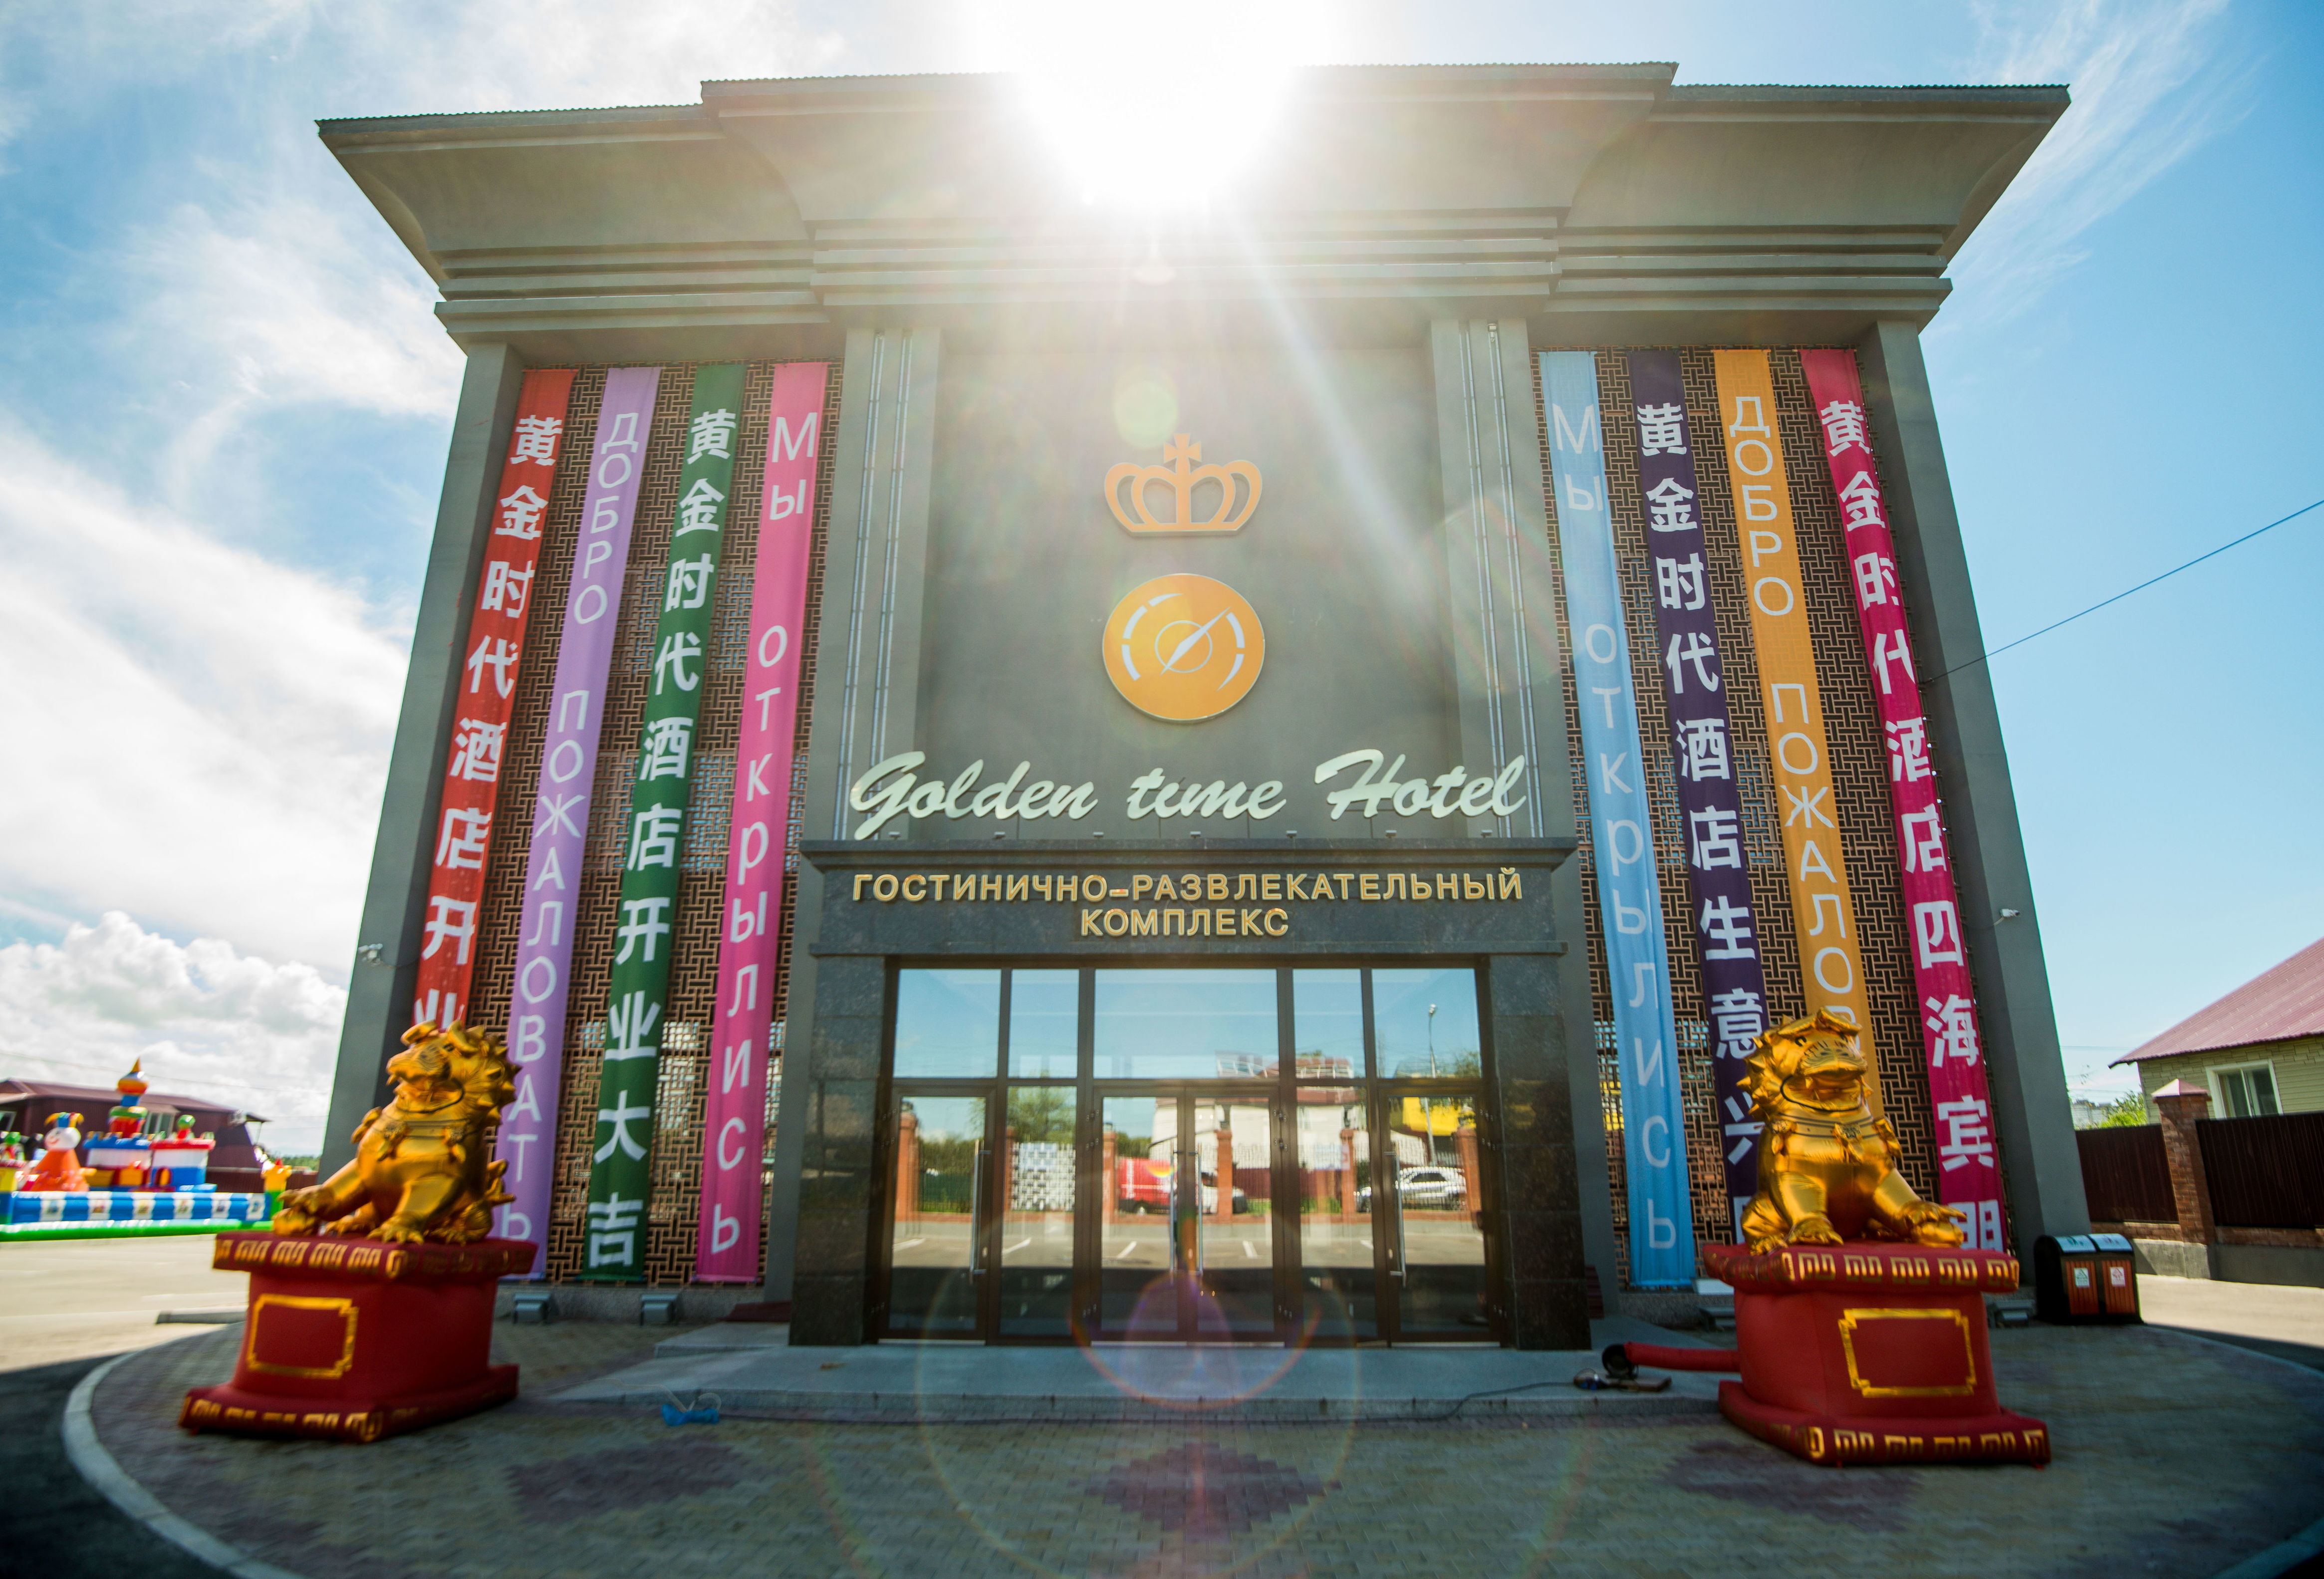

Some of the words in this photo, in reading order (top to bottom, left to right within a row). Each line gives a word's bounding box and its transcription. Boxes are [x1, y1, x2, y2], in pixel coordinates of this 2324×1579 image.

[573, 412, 640, 624] ДОБРО
[1729, 396, 1795, 616] ДОБРО
[588, 408, 737, 1268] 黄金时代酒店开业大吉
[850, 751, 1098, 840] Golden
[1314, 749, 1527, 820] Hotel
[852, 867, 1523, 902] ГОСТИНИЧНО-РАЗВЛЕКАТЕЛЬНЫЙ
[1637, 402, 1765, 1244] 黄金时代酒店生意兴
[501, 690, 590, 1240] ПОЖАЛОВАТЬ
[1081, 908, 1289, 936] КОМПЛЕКС
